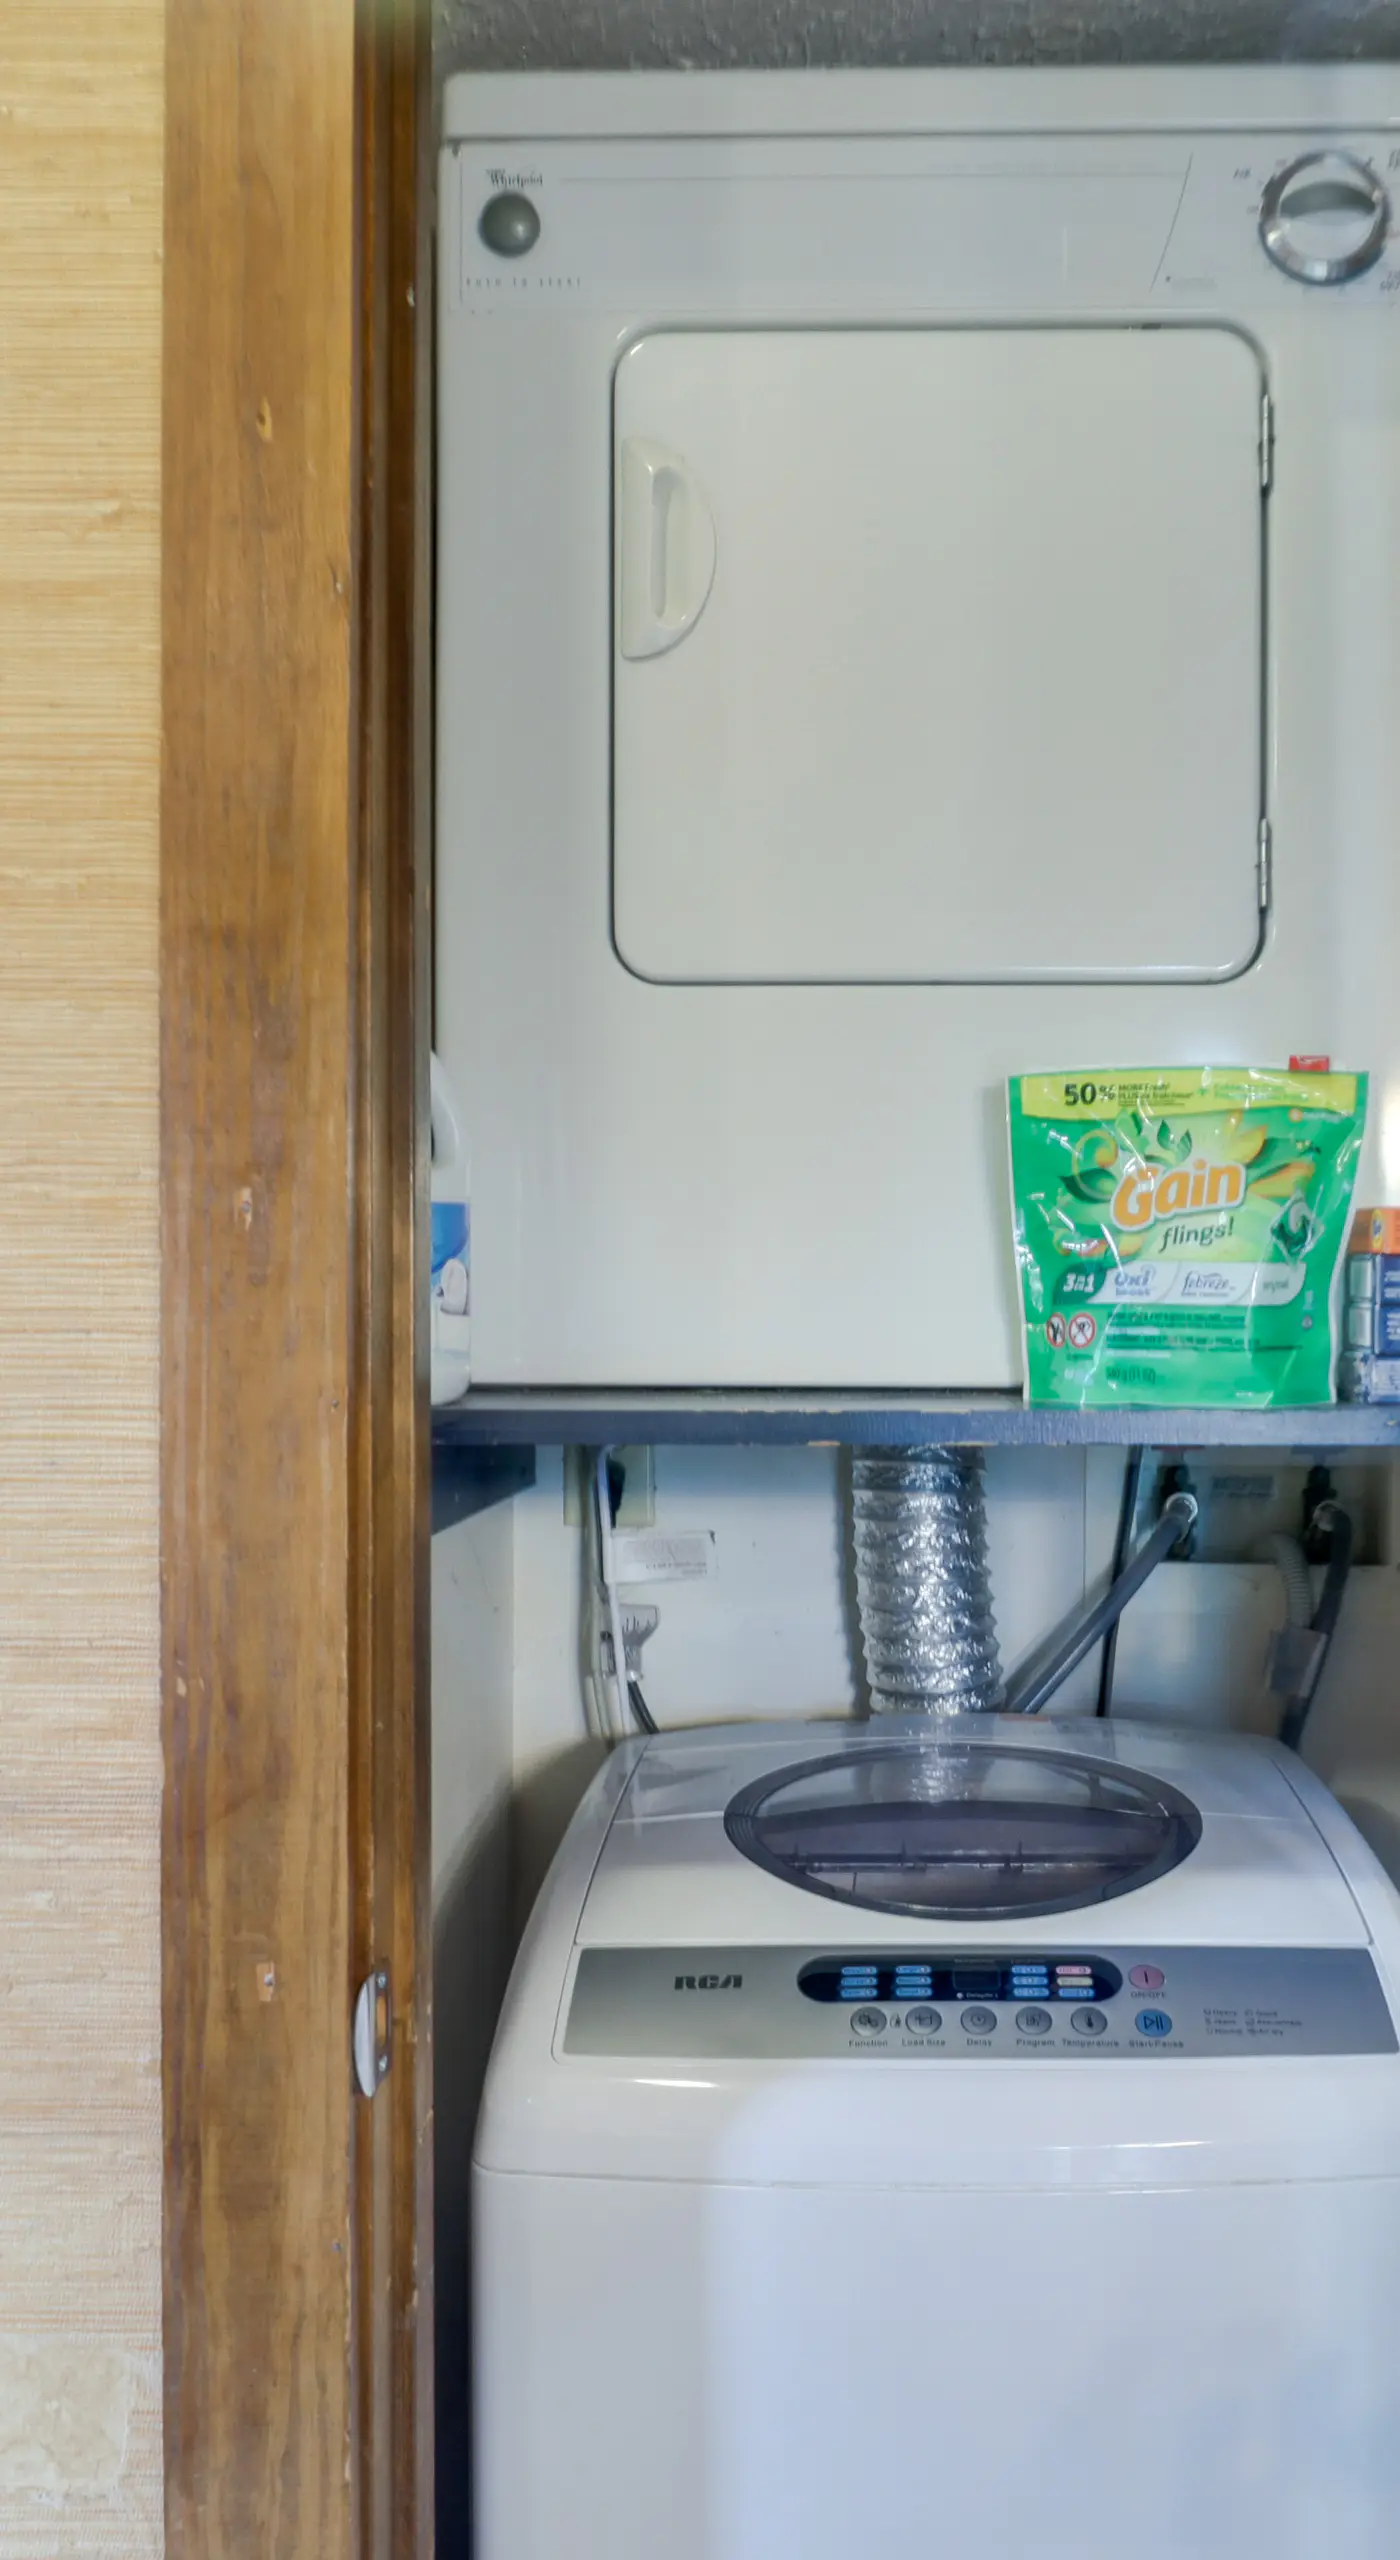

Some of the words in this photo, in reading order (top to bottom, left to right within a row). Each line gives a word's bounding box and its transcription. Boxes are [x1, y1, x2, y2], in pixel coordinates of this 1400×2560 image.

[484, 168, 543, 188] Whirlpool
[1112, 1158, 1242, 1228] Gain
[1158, 1215, 1234, 1254] flings!
[674, 1974, 743, 1989] RCA
[848, 2038, 888, 2048] Function
[966, 2037, 992, 2048] Delay
[1016, 2038, 1055, 2049] Program
[1062, 2038, 1119, 2049] Temperature
